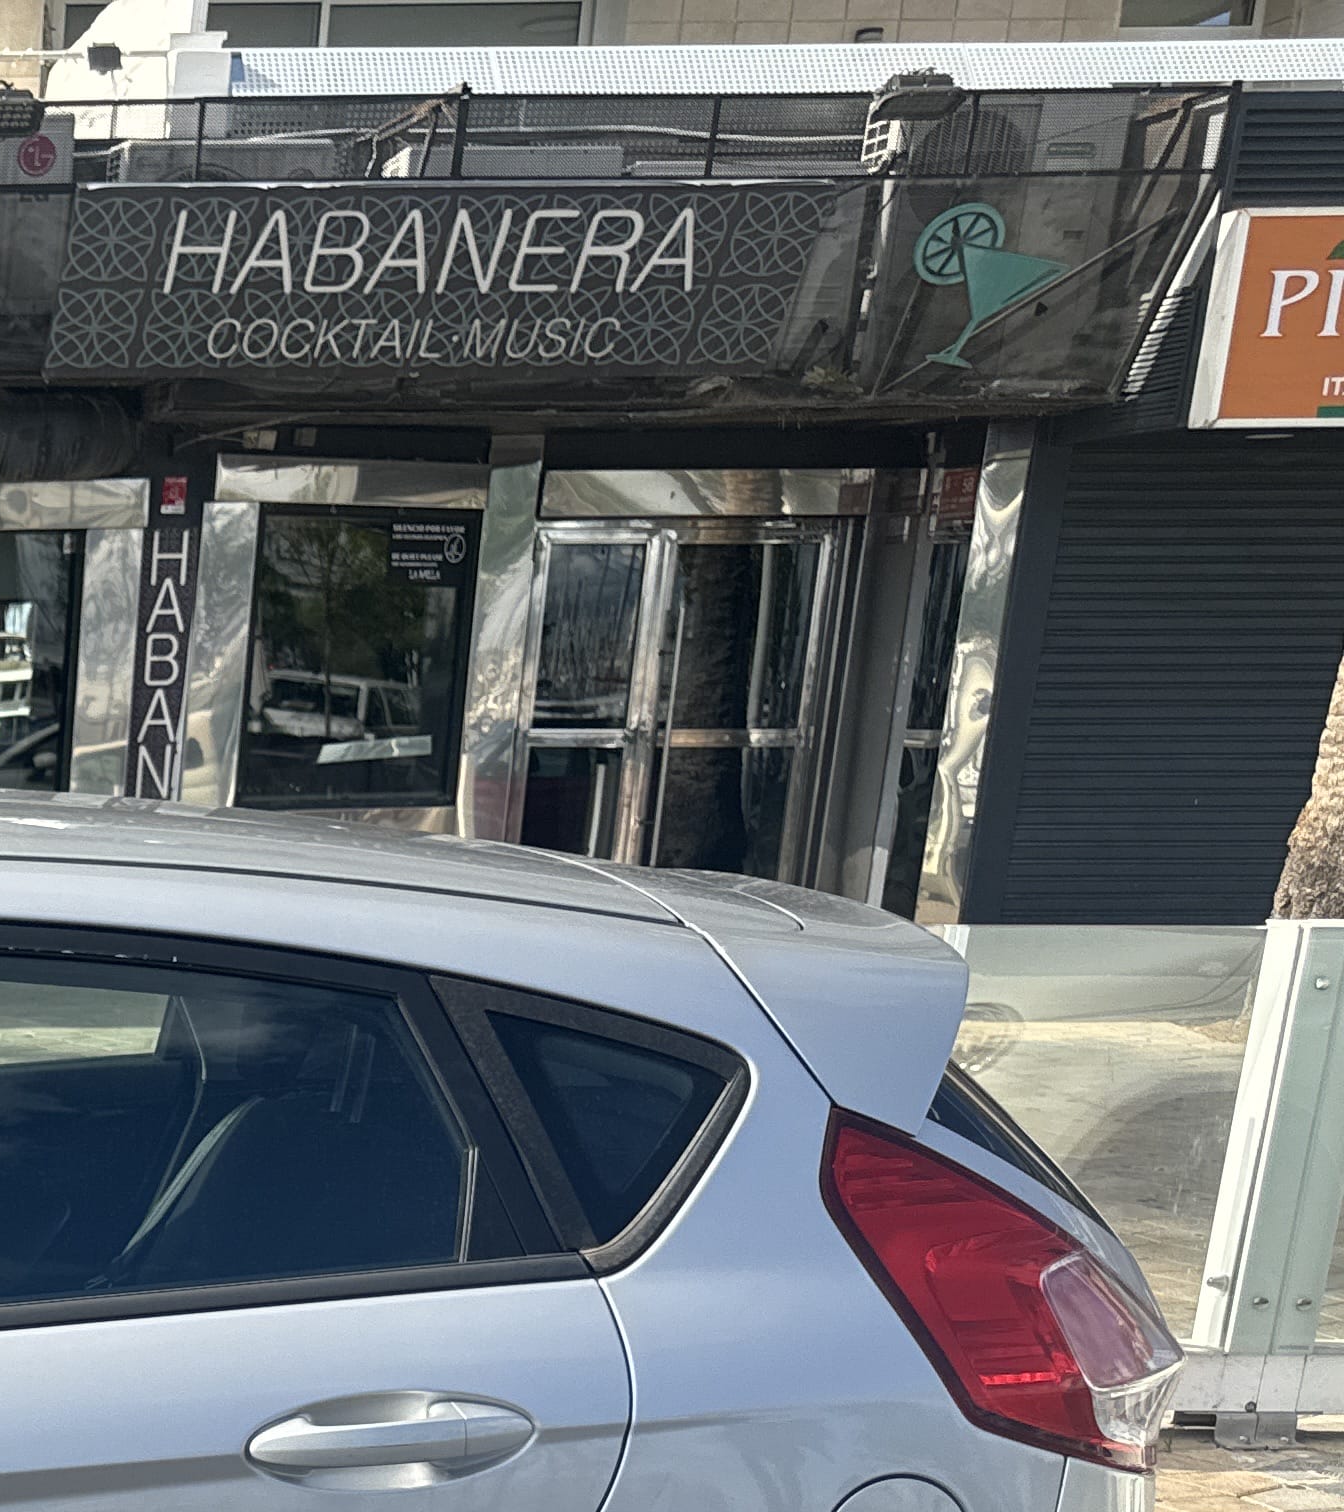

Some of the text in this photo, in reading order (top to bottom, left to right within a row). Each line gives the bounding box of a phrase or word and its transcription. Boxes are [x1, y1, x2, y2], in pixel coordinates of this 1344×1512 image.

[162, 207, 695, 295] HABANERA
[1322, 376, 1344, 397] IT
[135, 529, 190, 799] HABAN
